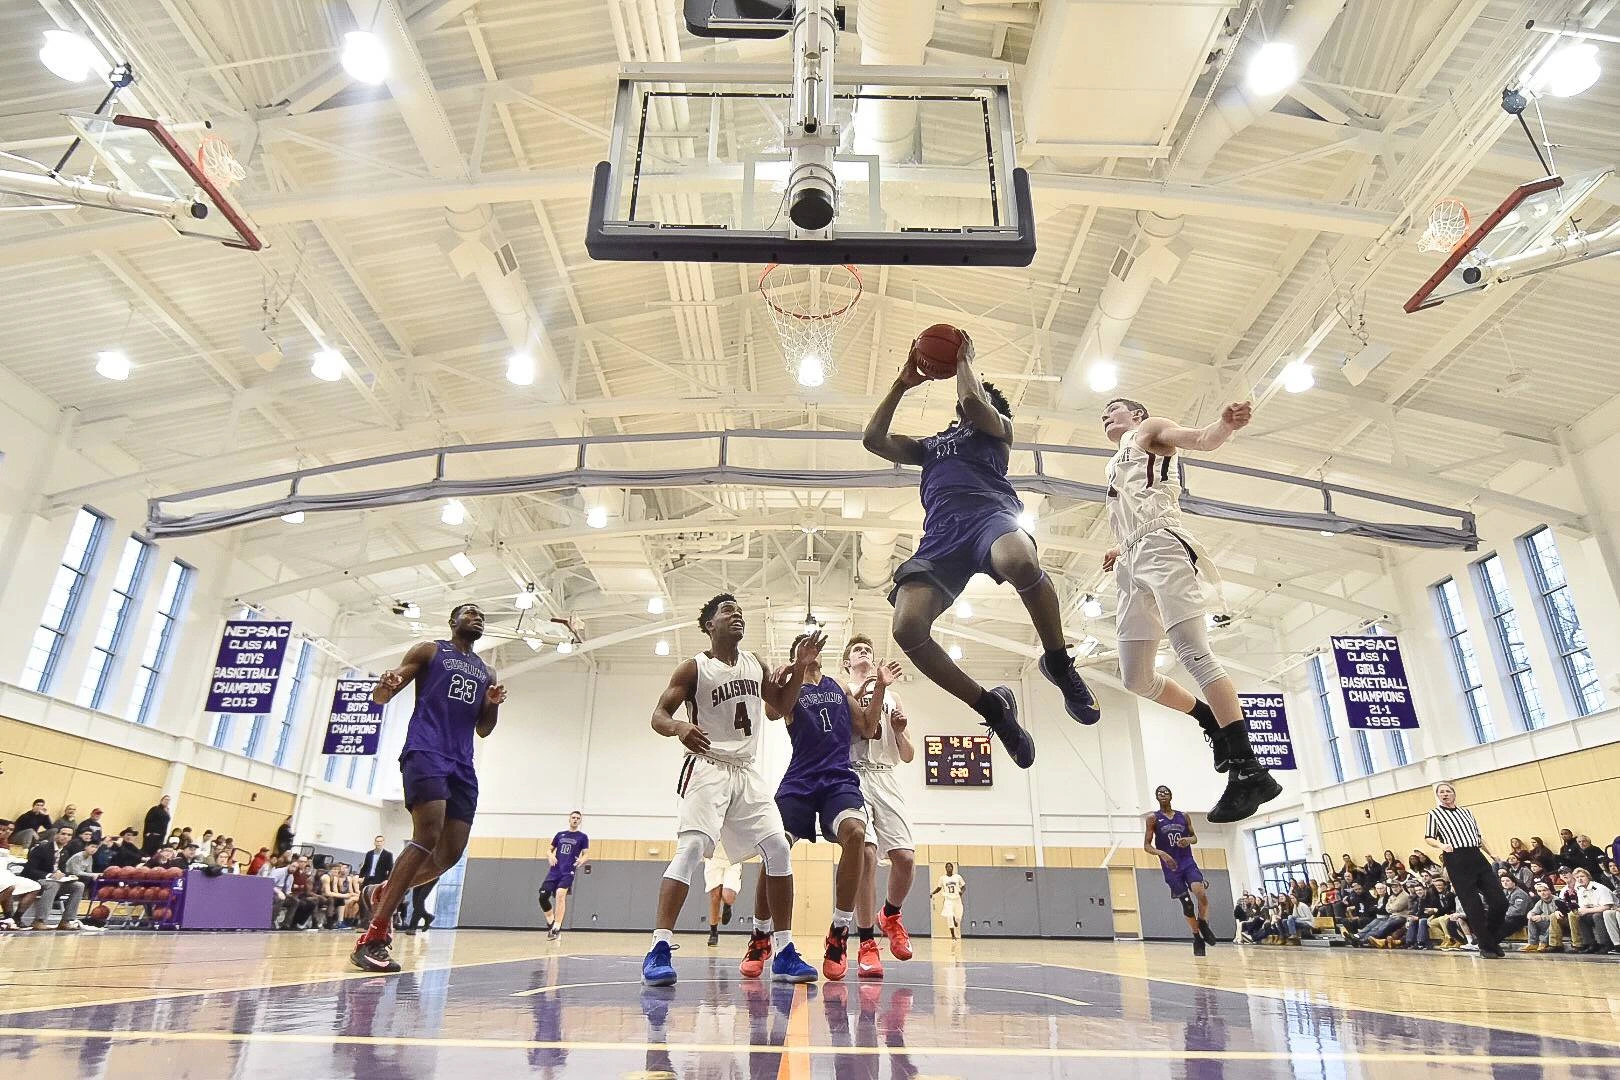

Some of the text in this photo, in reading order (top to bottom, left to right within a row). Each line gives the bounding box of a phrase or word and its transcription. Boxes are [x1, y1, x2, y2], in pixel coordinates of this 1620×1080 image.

[224, 626, 289, 638] NEPSAC
[229, 640, 277, 650] CLASS AA
[1332, 638, 1396, 650] NEPSAC
[236, 652, 264, 664] BOYS
[1346, 652, 1390, 662] CLASS A
[214, 667, 279, 679] BASKETBALL
[1356, 664, 1386, 675] GIRLS
[213, 682, 271, 694] CHAMPIONS
[448, 673, 477, 704] 23
[1340, 677, 1408, 689] BASKETBALL
[341, 693, 367, 701] CLASS
[1348, 690, 1406, 703] CHAMPIONS
[221, 698, 258, 707] 2013
[346, 702, 369, 712] BOYS
[1239, 697, 1284, 708] EPSAC
[330, 712, 382, 723] BASKETBALL
[734, 701, 752, 737] 4
[820, 708, 833, 732] 1
[1365, 716, 1401, 727] 1995
[331, 724, 377, 734] CHAMPIONS
[1249, 720, 1272, 730] BOYS
[1248, 732, 1290, 742] SKETBALL
[335, 745, 365, 753] 2014
[1251, 745, 1289, 755] AMPIONS
